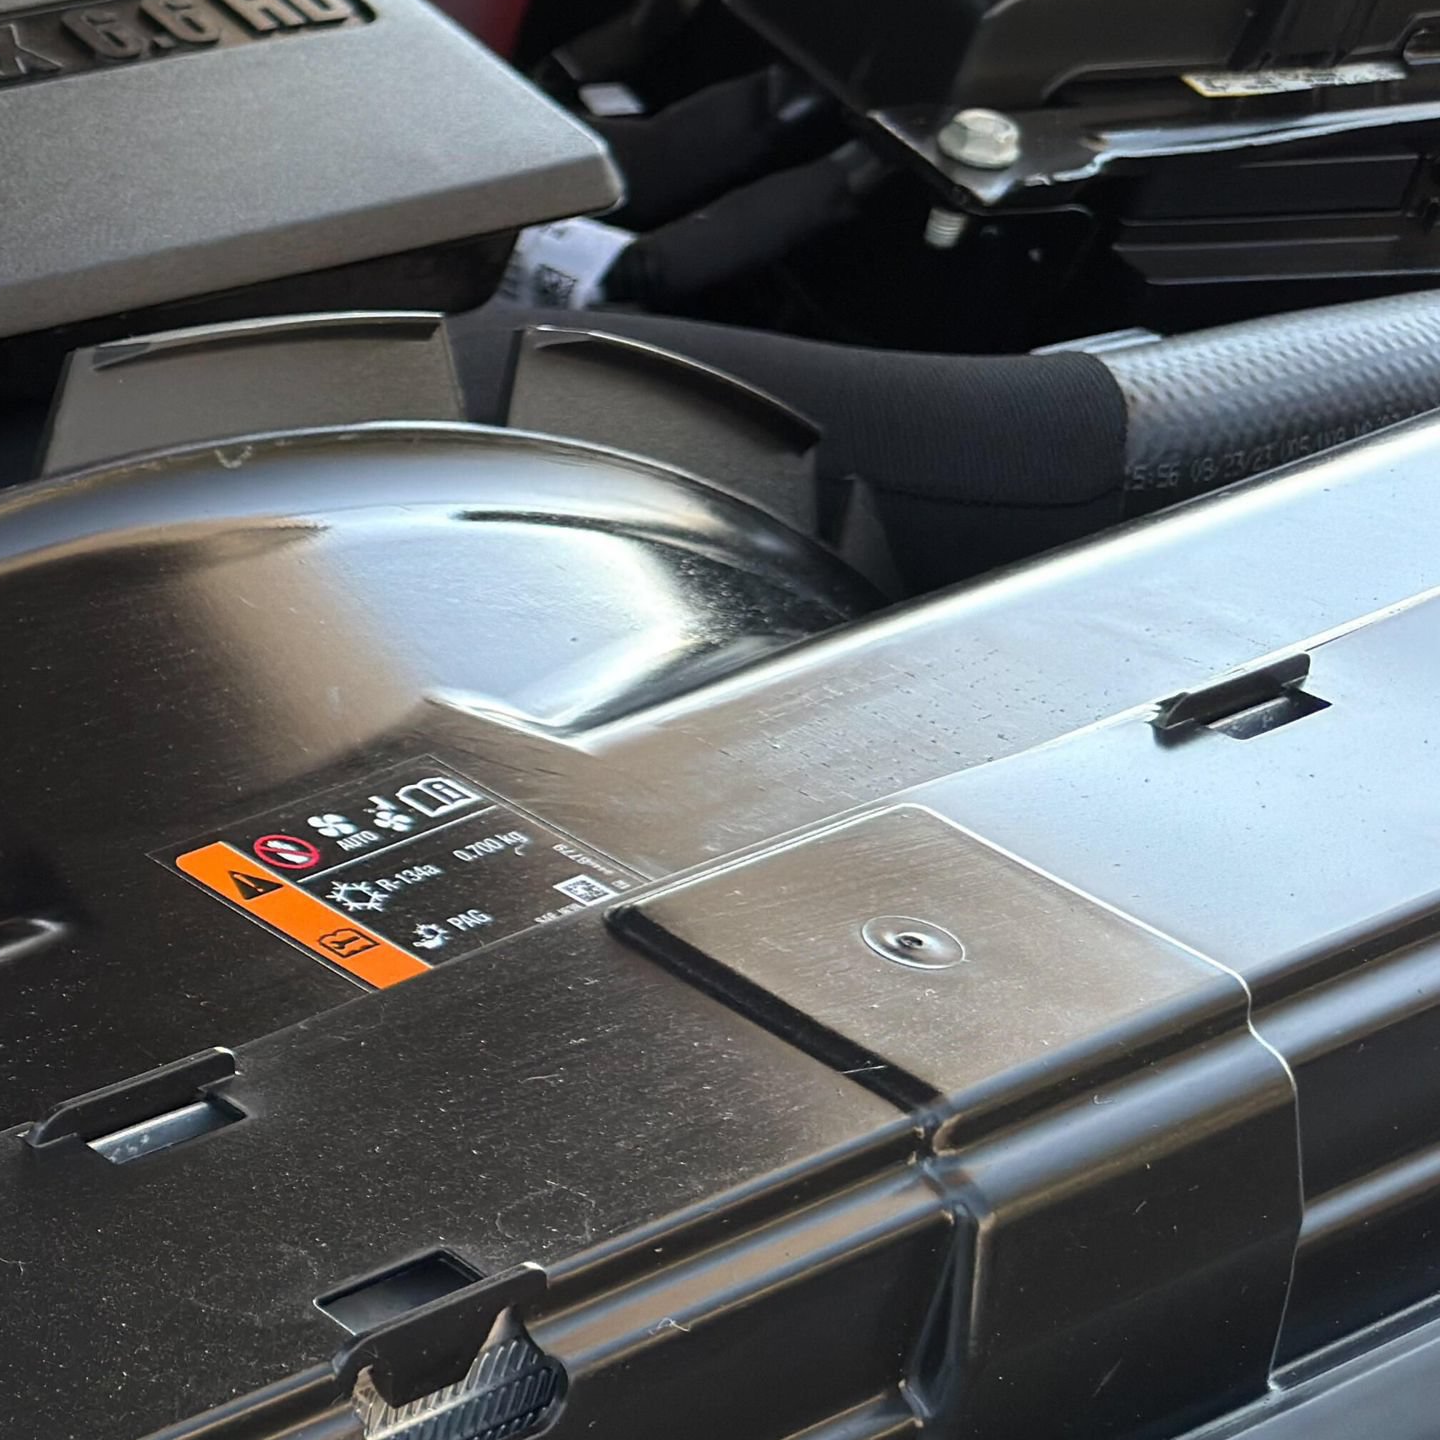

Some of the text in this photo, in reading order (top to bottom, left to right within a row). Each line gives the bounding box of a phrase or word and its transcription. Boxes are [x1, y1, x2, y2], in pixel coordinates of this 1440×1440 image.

[336, 830, 379, 852] AUTO
[375, 829, 529, 893] R-134a 0.700 kg
[446, 909, 492, 932] PAG
